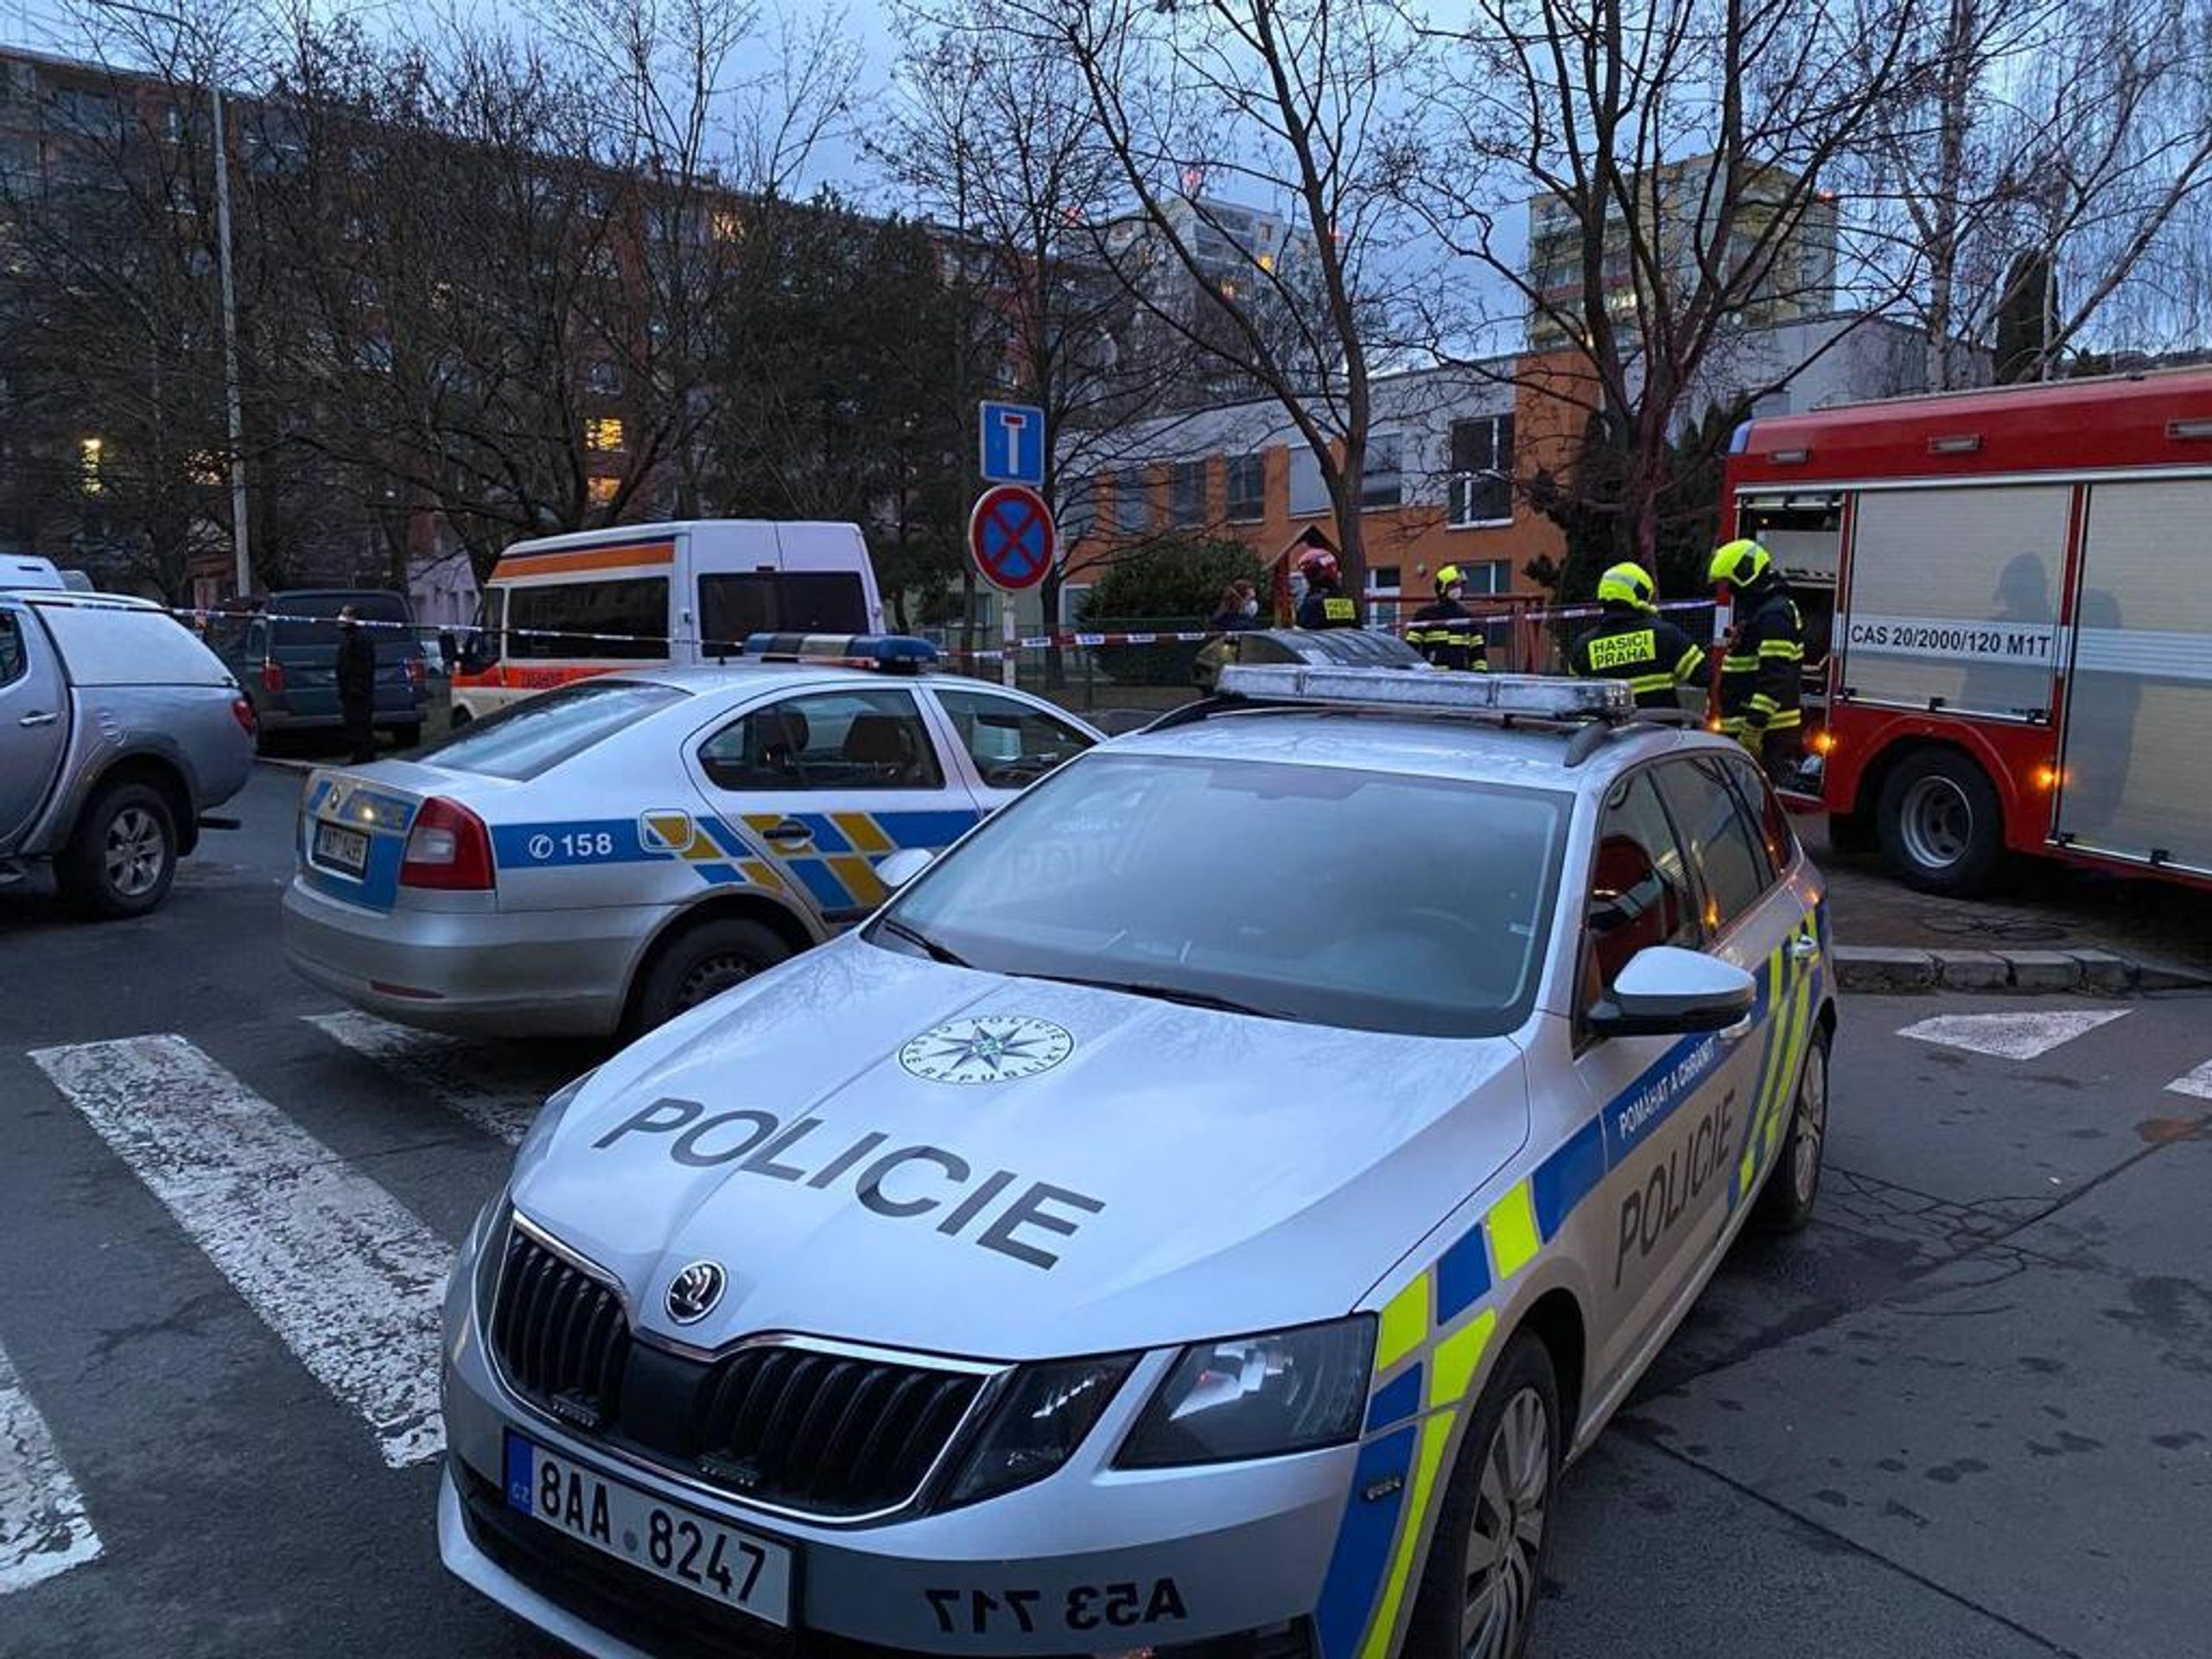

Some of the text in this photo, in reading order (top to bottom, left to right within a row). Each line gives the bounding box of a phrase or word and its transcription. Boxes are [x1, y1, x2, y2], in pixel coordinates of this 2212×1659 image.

[1594, 645, 1649, 668] PRAHA
[1851, 624, 2052, 658] CAS 20/2000/120 M1T
[561, 832, 613, 857] 158
[1669, 1071, 1680, 1096] A
[590, 1096, 1107, 1272] POLICIE
[1614, 1087, 1736, 1289] POLICIE
[539, 1460, 766, 1602] 8AA 8247
